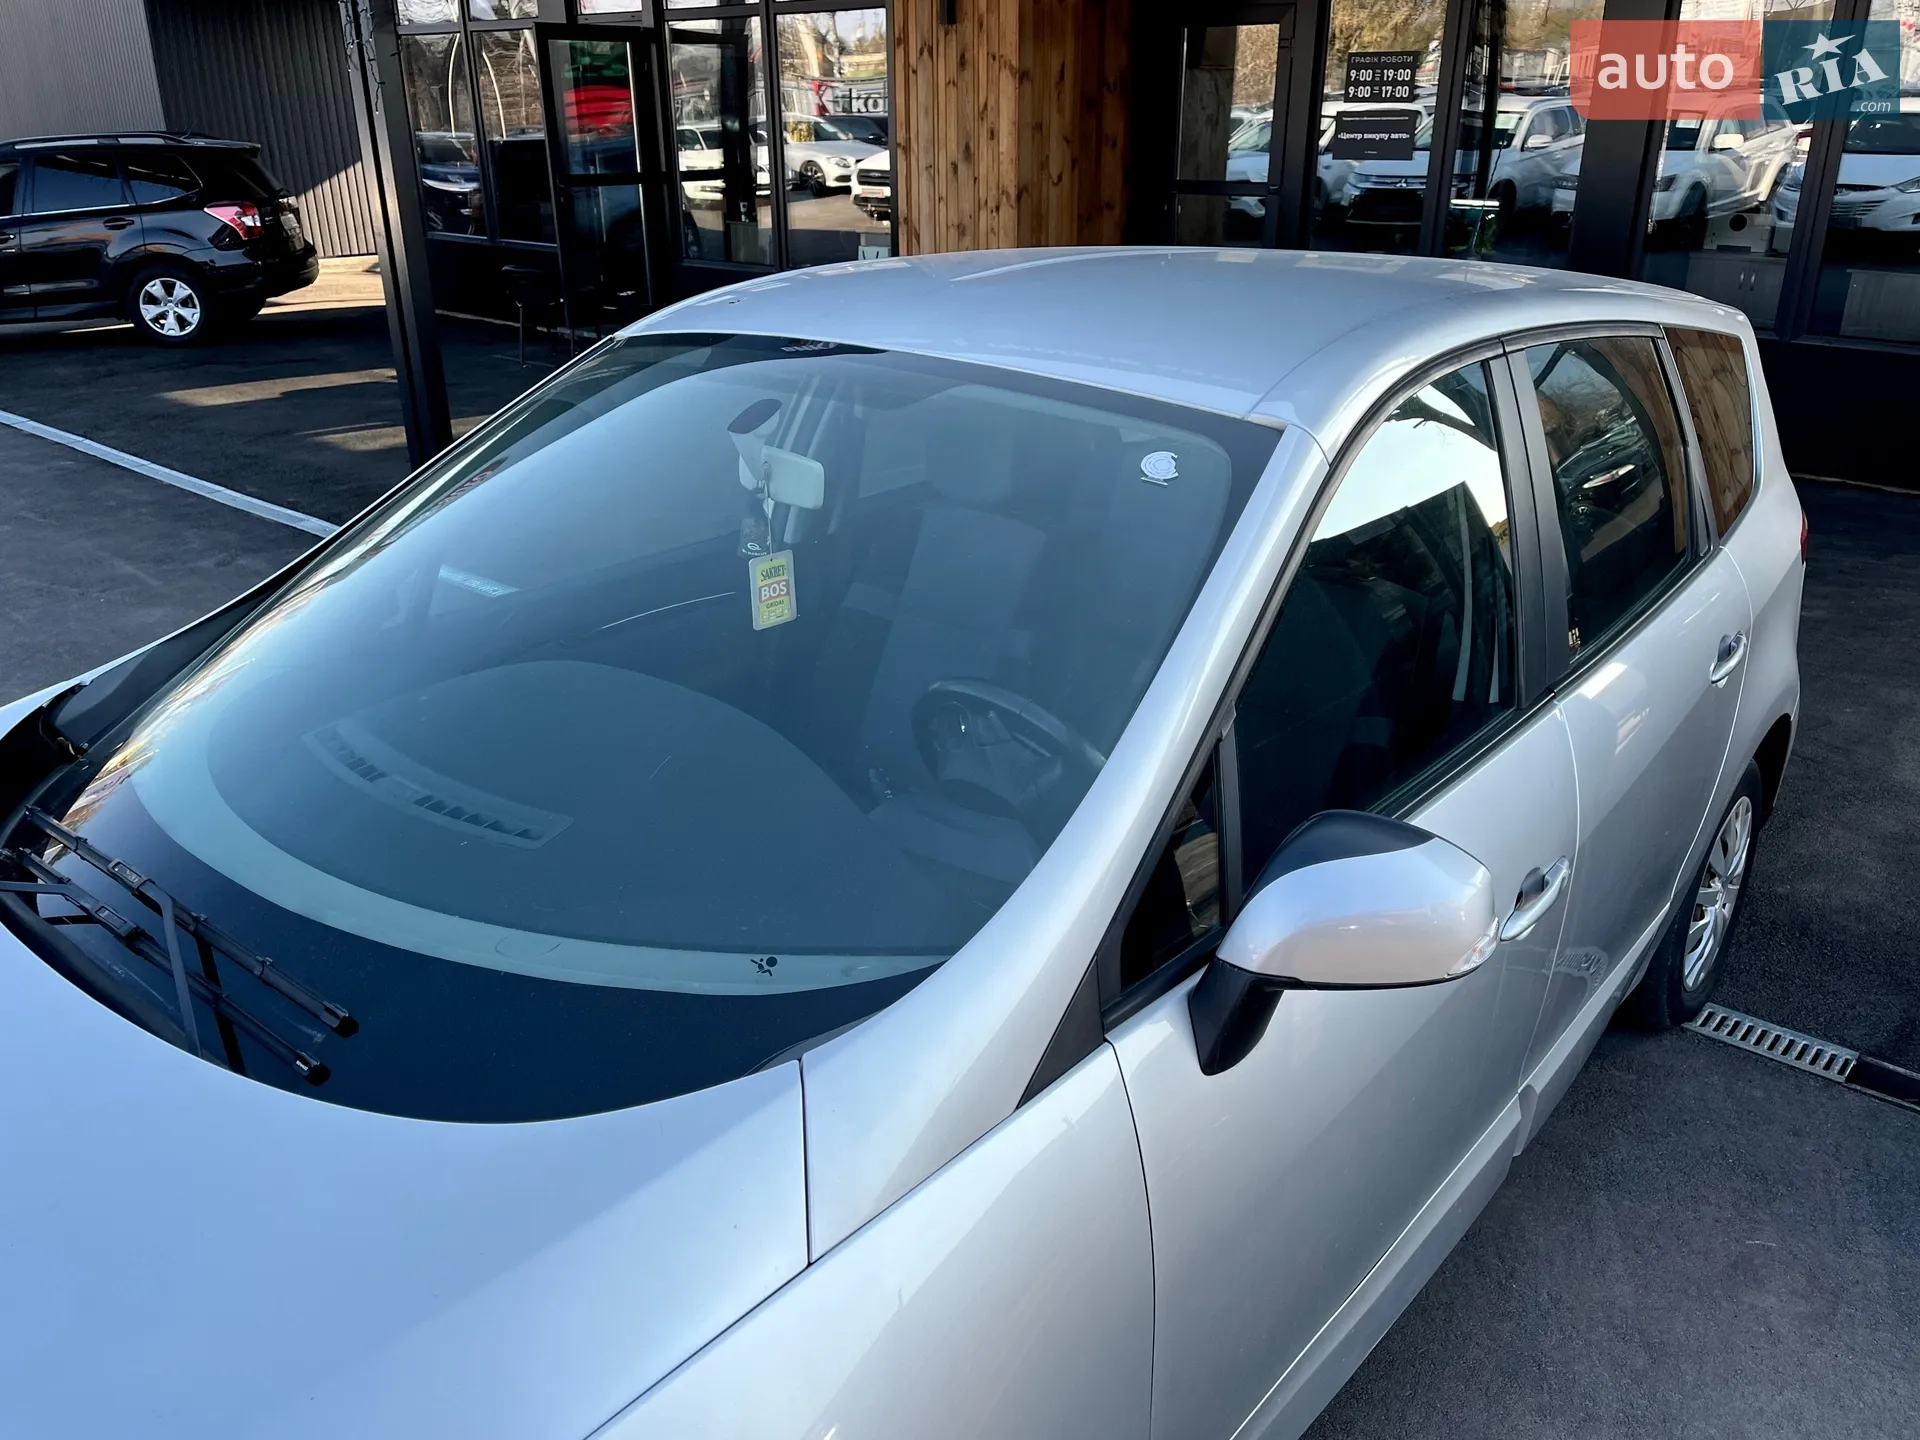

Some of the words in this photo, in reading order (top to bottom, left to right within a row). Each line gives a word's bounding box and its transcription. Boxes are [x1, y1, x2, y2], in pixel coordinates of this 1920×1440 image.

[1381, 55, 1414, 63] РОБОТИ
[1350, 69, 1373, 81] 9:00
[1383, 69, 1411, 81] 19:00
[1348, 86, 1371, 98] 9:00
[1381, 86, 1410, 98] 17:00
[761, 582, 787, 601] BOS
